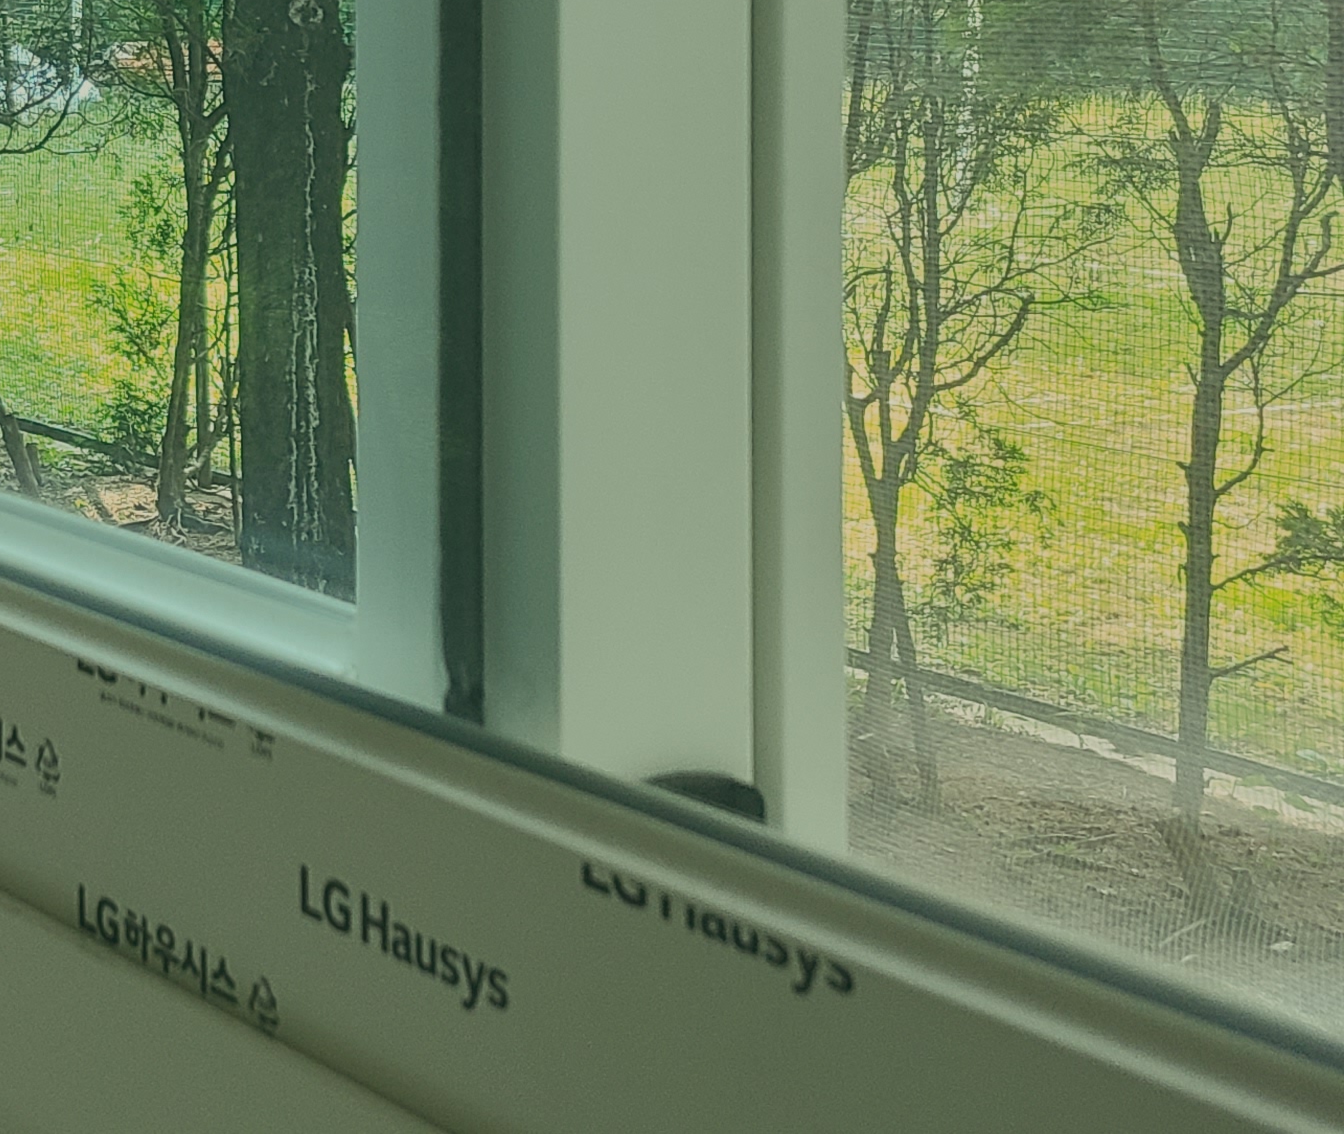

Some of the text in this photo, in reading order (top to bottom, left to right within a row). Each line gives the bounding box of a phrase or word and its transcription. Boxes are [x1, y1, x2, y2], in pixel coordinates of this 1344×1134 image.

[78, 882, 239, 1004] LG하우시스
[300, 864, 510, 1010] LG Hausys
